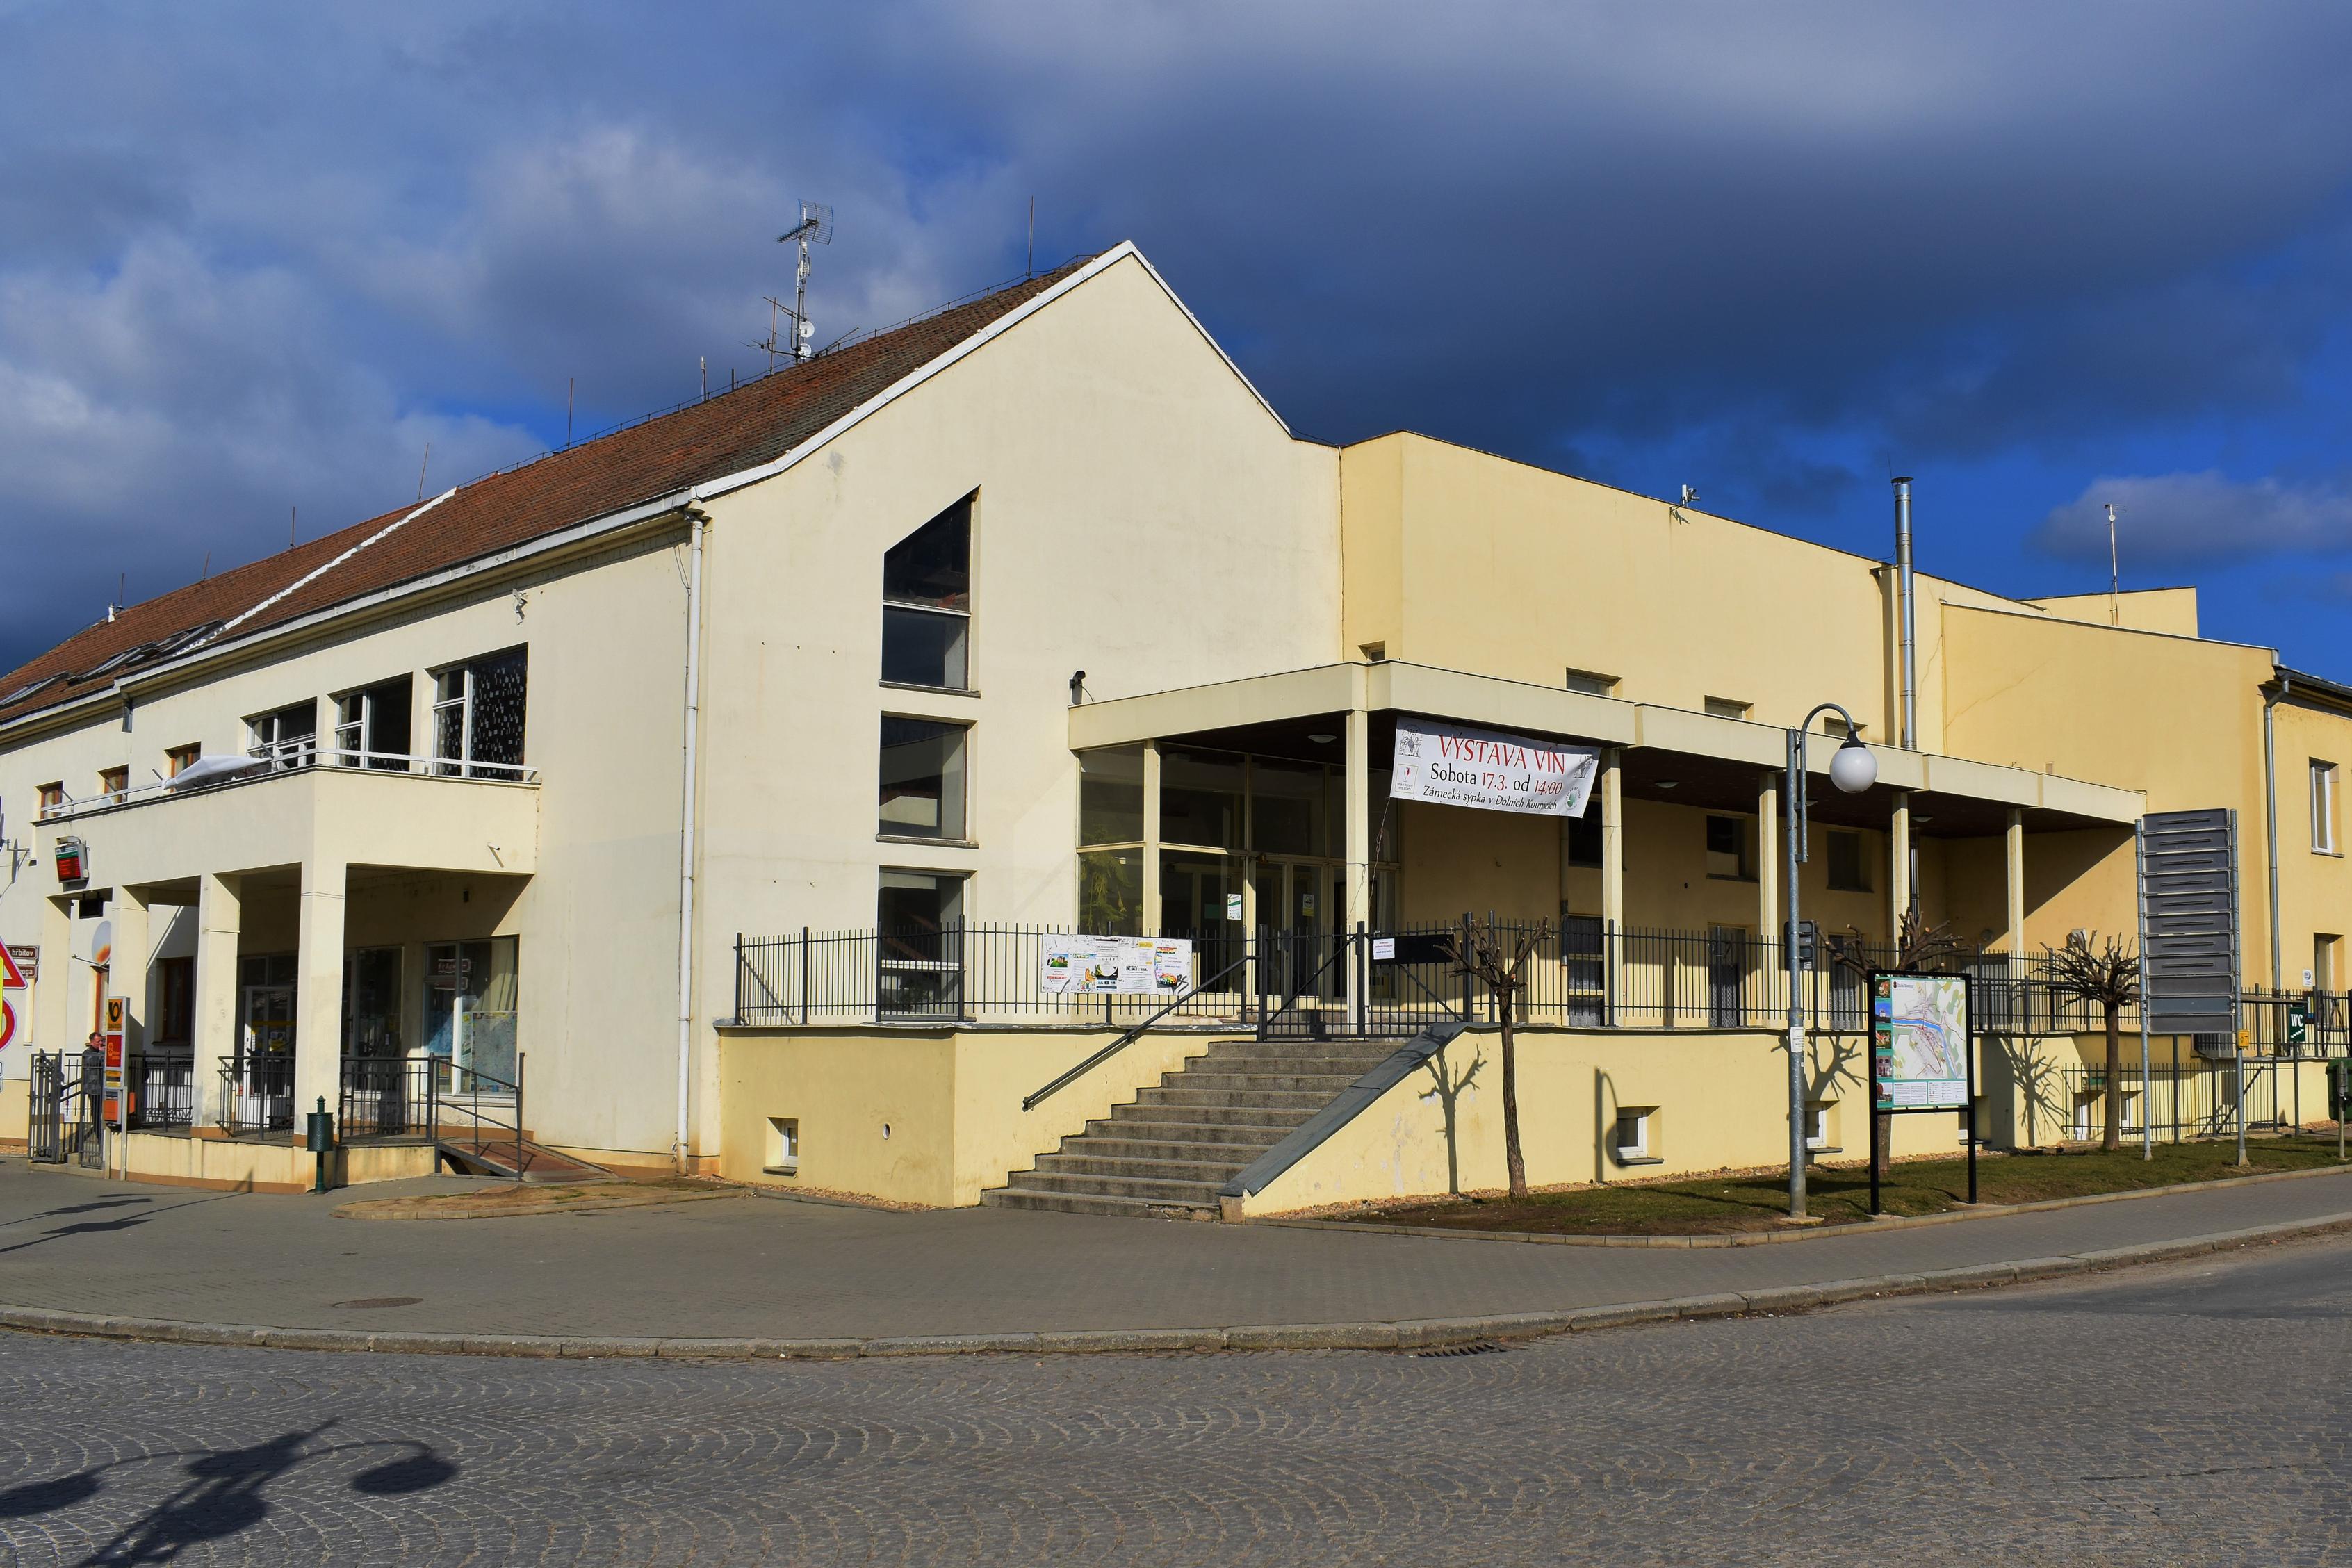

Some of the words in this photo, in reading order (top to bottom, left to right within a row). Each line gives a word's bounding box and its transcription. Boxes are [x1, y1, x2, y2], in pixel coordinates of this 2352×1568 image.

[1439, 732, 1526, 769] VÝSTAVA
[1533, 746, 1565, 774] VÍN
[1430, 762, 1476, 785] Sobota
[1482, 772, 1508, 791] 17.3.
[1513, 774, 1530, 792] od
[1534, 780, 1563, 796] 14:00
[1423, 785, 1460, 800] Zámecká
[1462, 792, 1485, 806] sýpka
[1495, 795, 1524, 808] Dolních
[2290, 1014, 2304, 1027] WC
